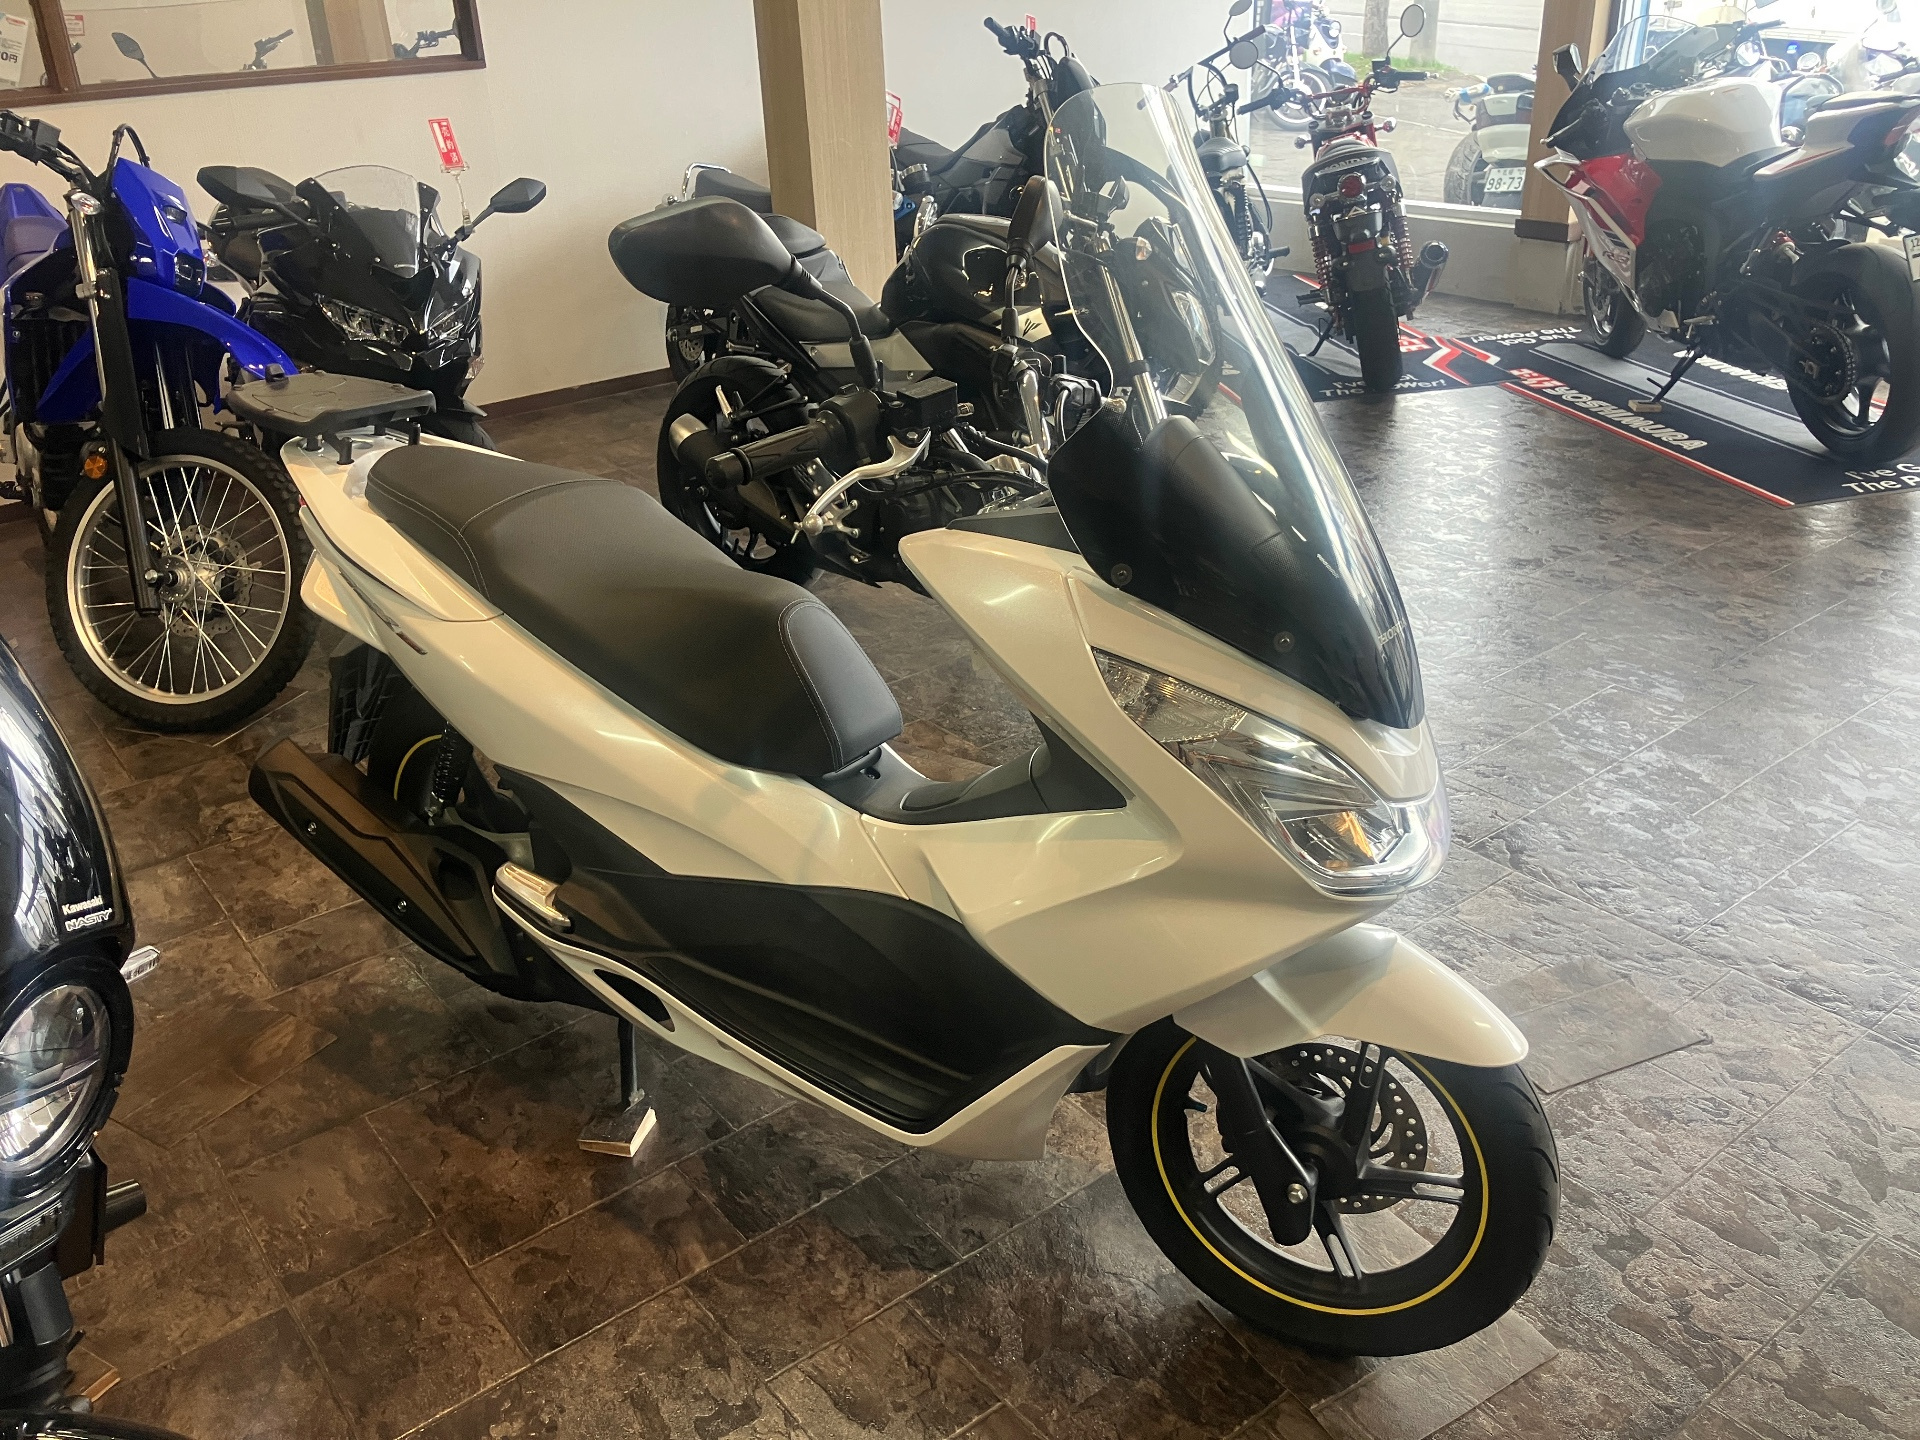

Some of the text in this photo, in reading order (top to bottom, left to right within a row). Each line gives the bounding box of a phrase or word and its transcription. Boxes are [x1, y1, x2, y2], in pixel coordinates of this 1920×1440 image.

[0, 50, 18, 63] 0円
[1470, 326, 1583, 343] The Power!
[1496, 337, 1537, 346] Got
[1319, 388, 1365, 397] The
[1542, 386, 1708, 450] YOSHIMURA
[1844, 469, 1897, 480] I've
[1841, 480, 1902, 493] The
[62, 894, 104, 916] Kawasaki
